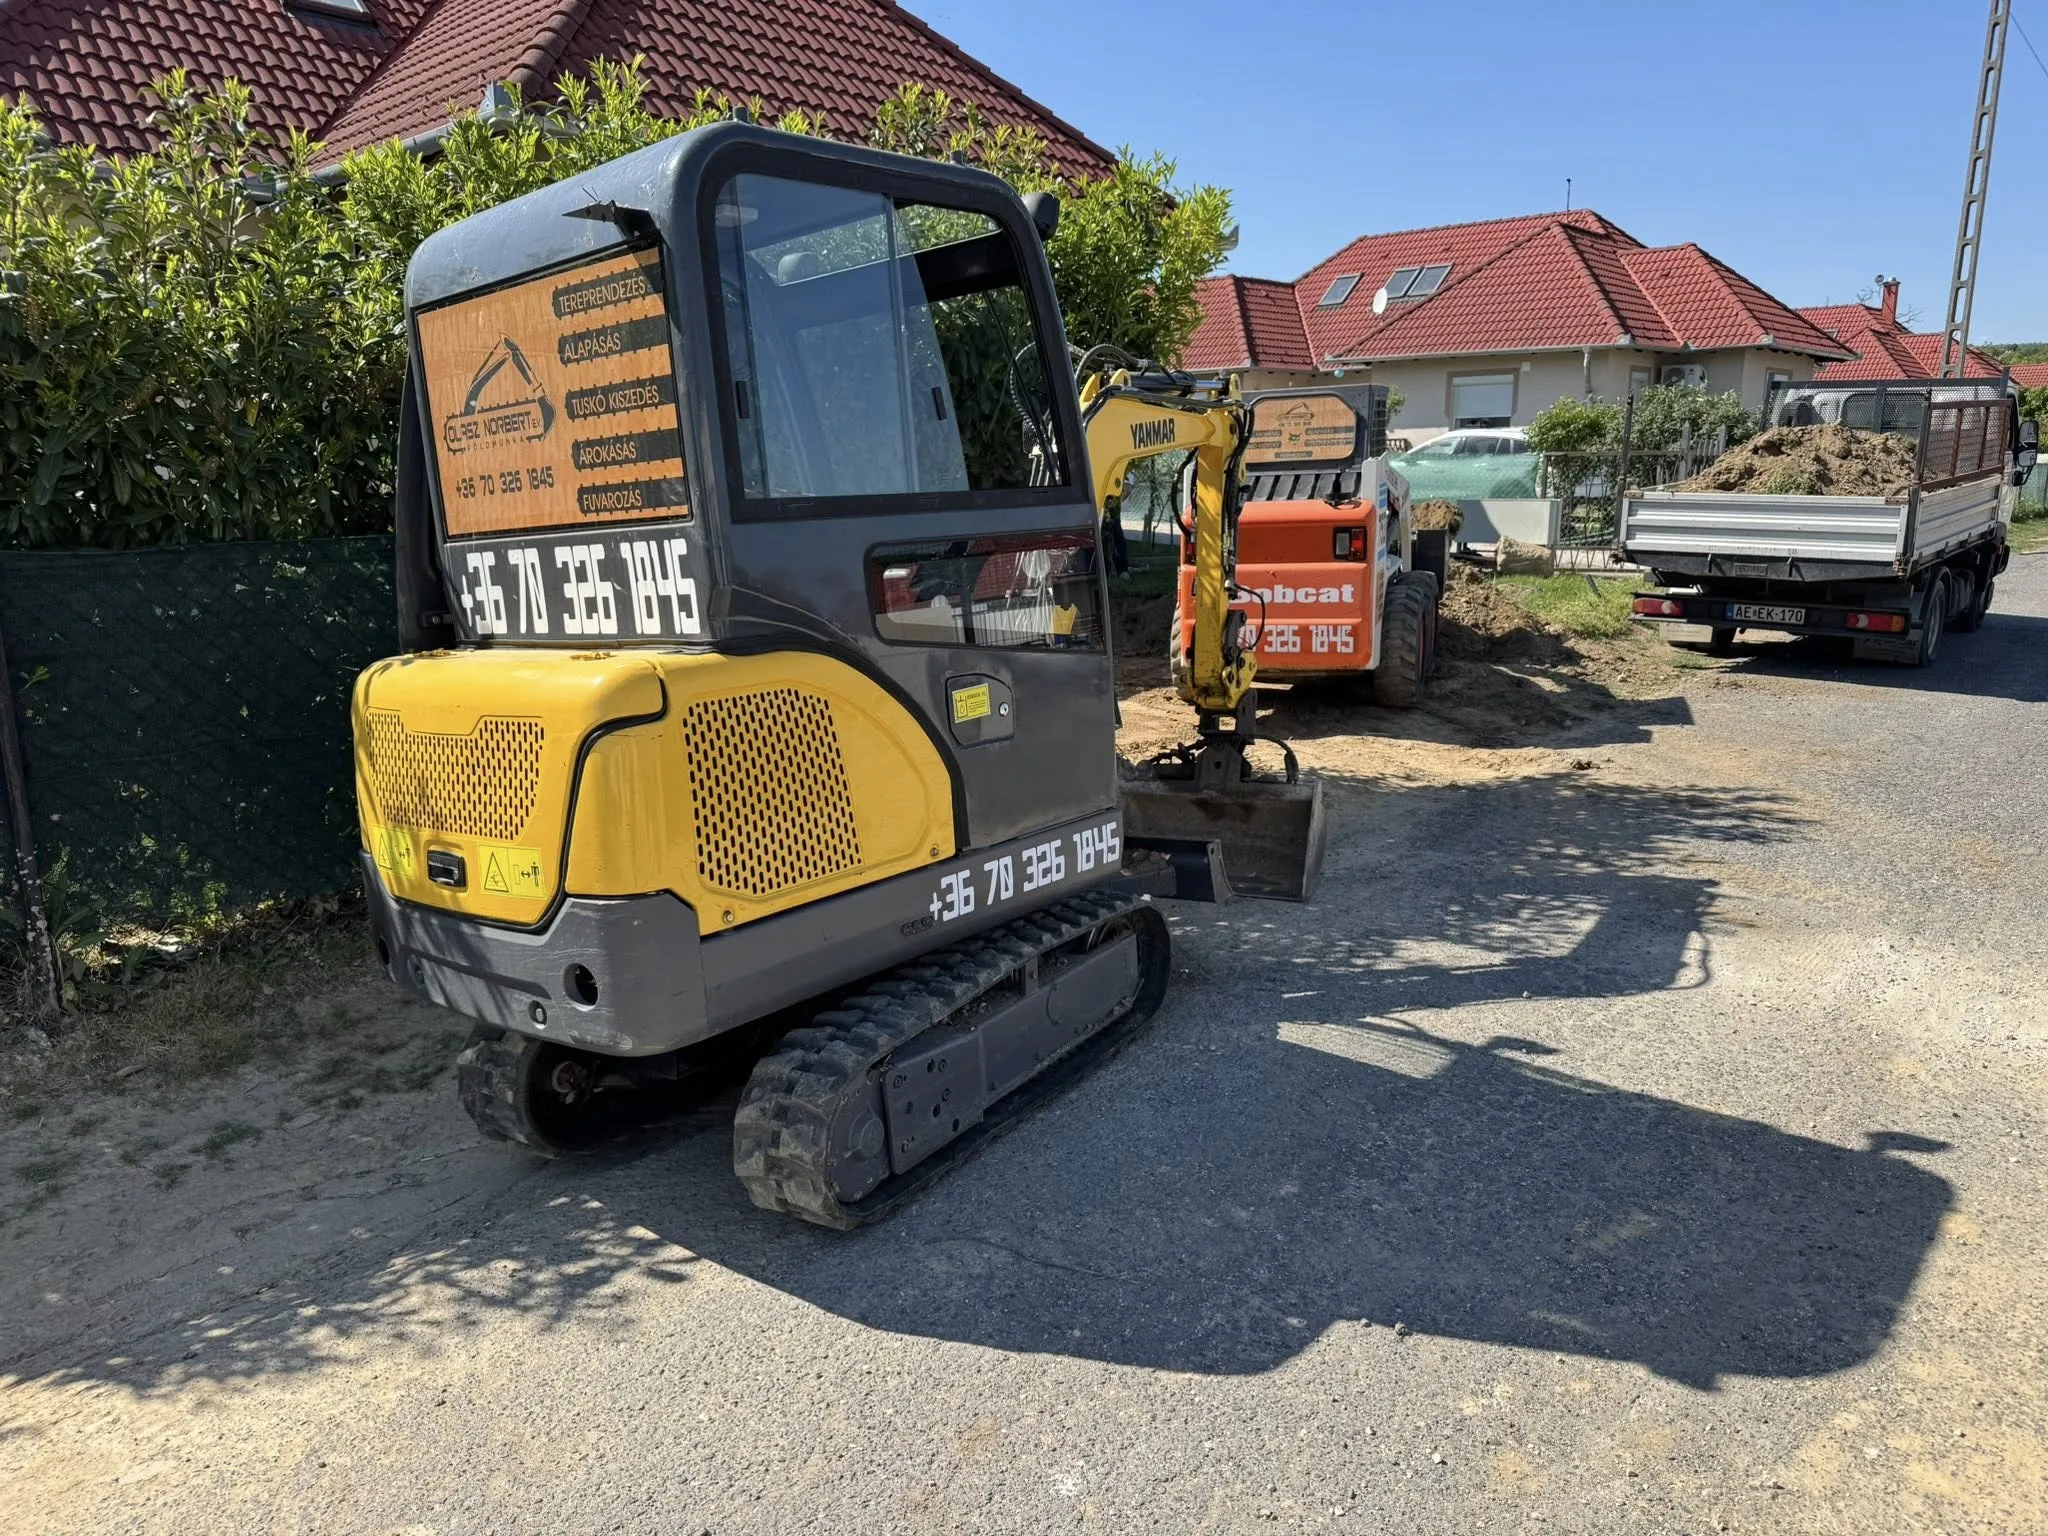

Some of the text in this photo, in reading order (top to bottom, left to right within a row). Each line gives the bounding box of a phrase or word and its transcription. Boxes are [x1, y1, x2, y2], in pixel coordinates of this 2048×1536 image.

[559, 272, 646, 313] TEREPRENDEZÉS
[564, 329, 621, 361] ALAPÁSÁS
[572, 381, 660, 416] TUSKÓ KISZEDÉS
[483, 411, 531, 437] NORBERT
[1130, 418, 1176, 449] YANMAR
[579, 437, 637, 465] ÁROKÁSÁS
[456, 466, 554, 498] +36 70 326 1845
[583, 485, 642, 511] FUVAROZÁS
[461, 538, 701, 635] +36 70 326 1845
[1264, 625, 1301, 653] 326
[1309, 625, 1354, 653] 1845
[930, 821, 1120, 921] +36 70 326 1845
